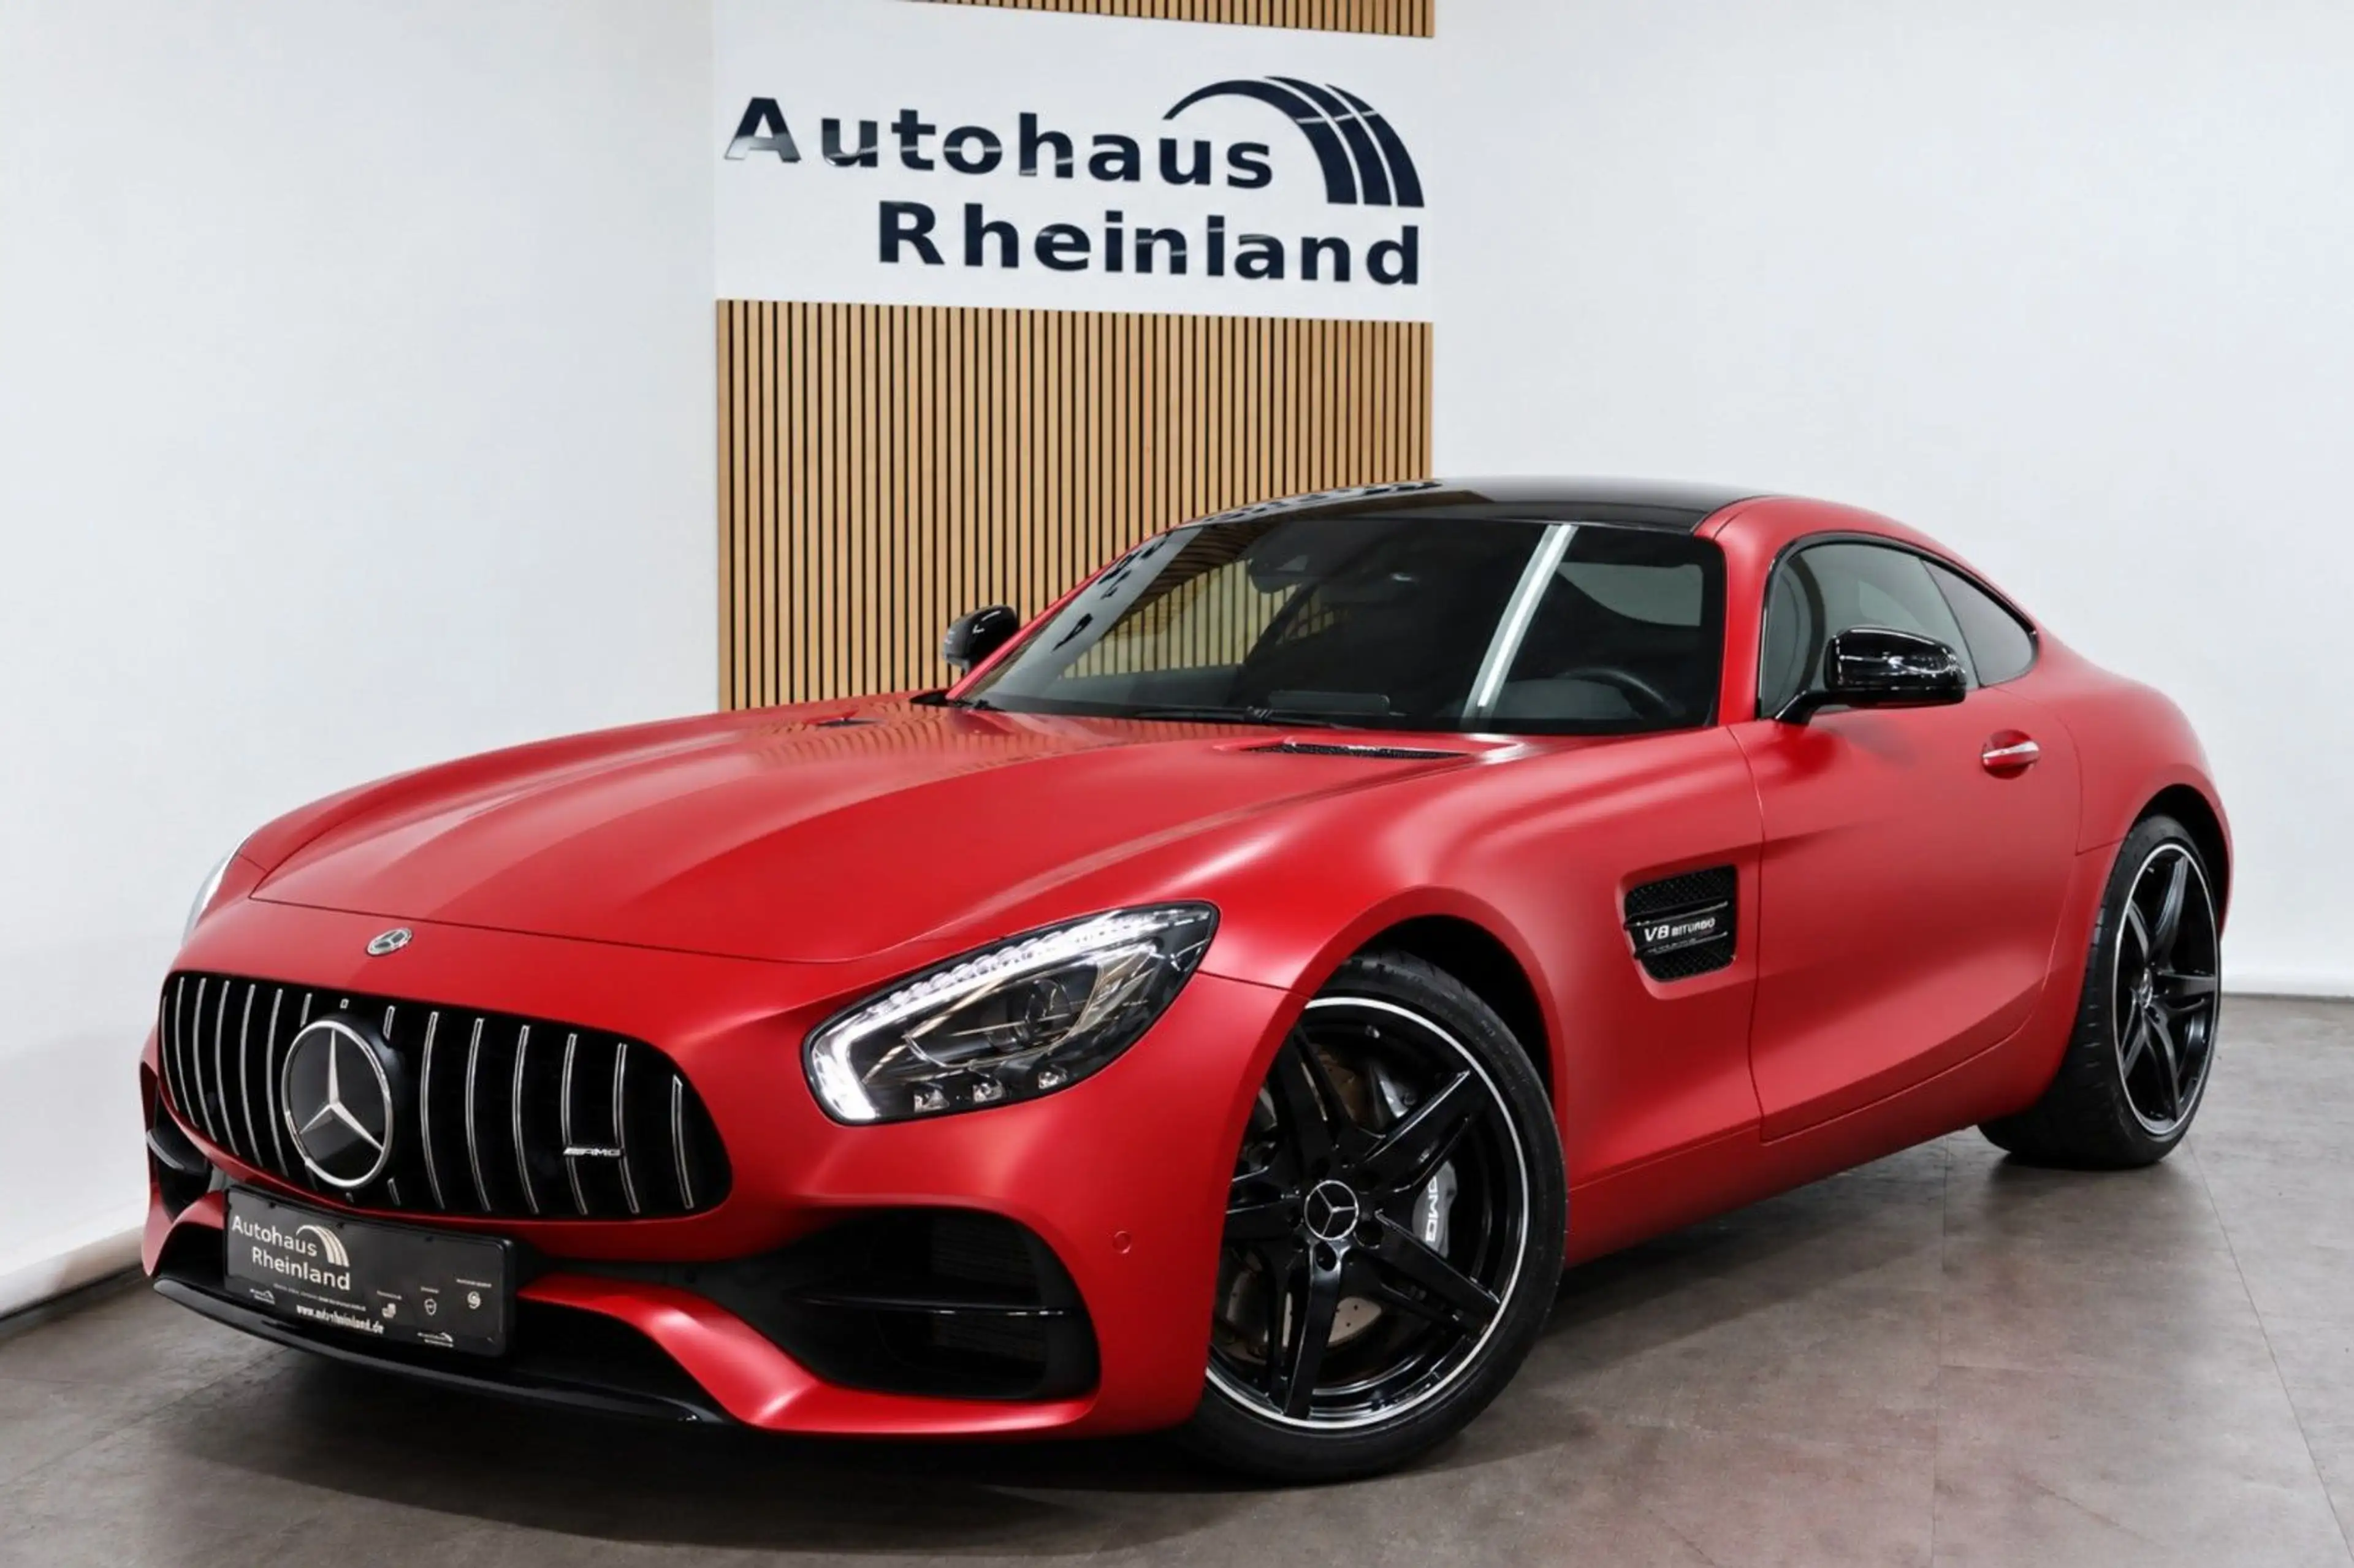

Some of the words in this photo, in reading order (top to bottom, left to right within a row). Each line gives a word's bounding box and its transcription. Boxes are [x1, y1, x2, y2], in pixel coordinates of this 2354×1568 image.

[724, 96, 1273, 190] Autohaus
[878, 200, 1419, 286] Rheinland
[1644, 924, 1669, 942] V8
[1671, 918, 1716, 937] BITURBO
[231, 1215, 318, 1257] Autohaus
[251, 1246, 351, 1291] Rheinland
